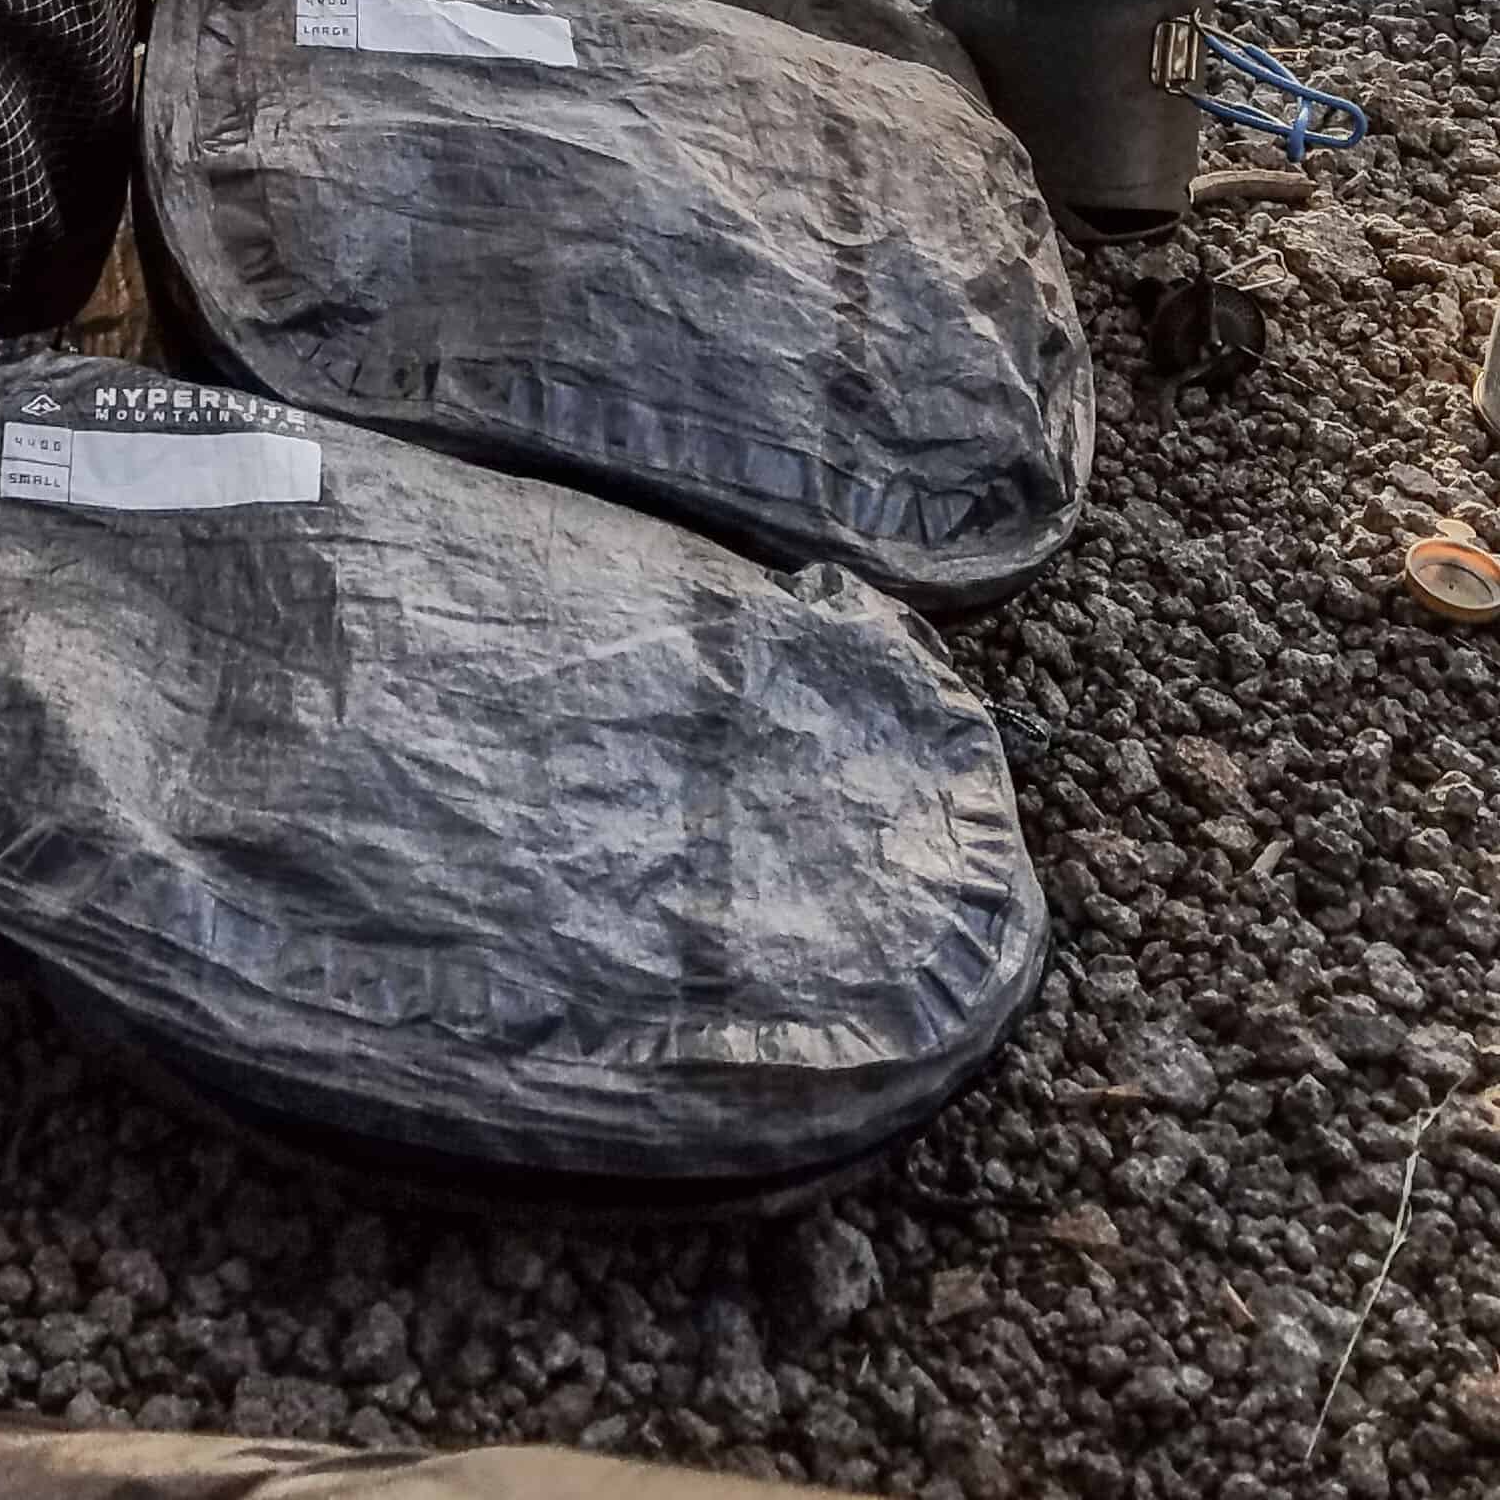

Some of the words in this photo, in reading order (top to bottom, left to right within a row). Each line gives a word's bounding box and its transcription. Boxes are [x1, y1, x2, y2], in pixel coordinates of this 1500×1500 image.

[303, 25, 350, 37] LARGE
[95, 387, 308, 425] HYPERLITE
[95, 407, 232, 423] MOUNTAIN
[8, 472, 61, 488] SMALL
